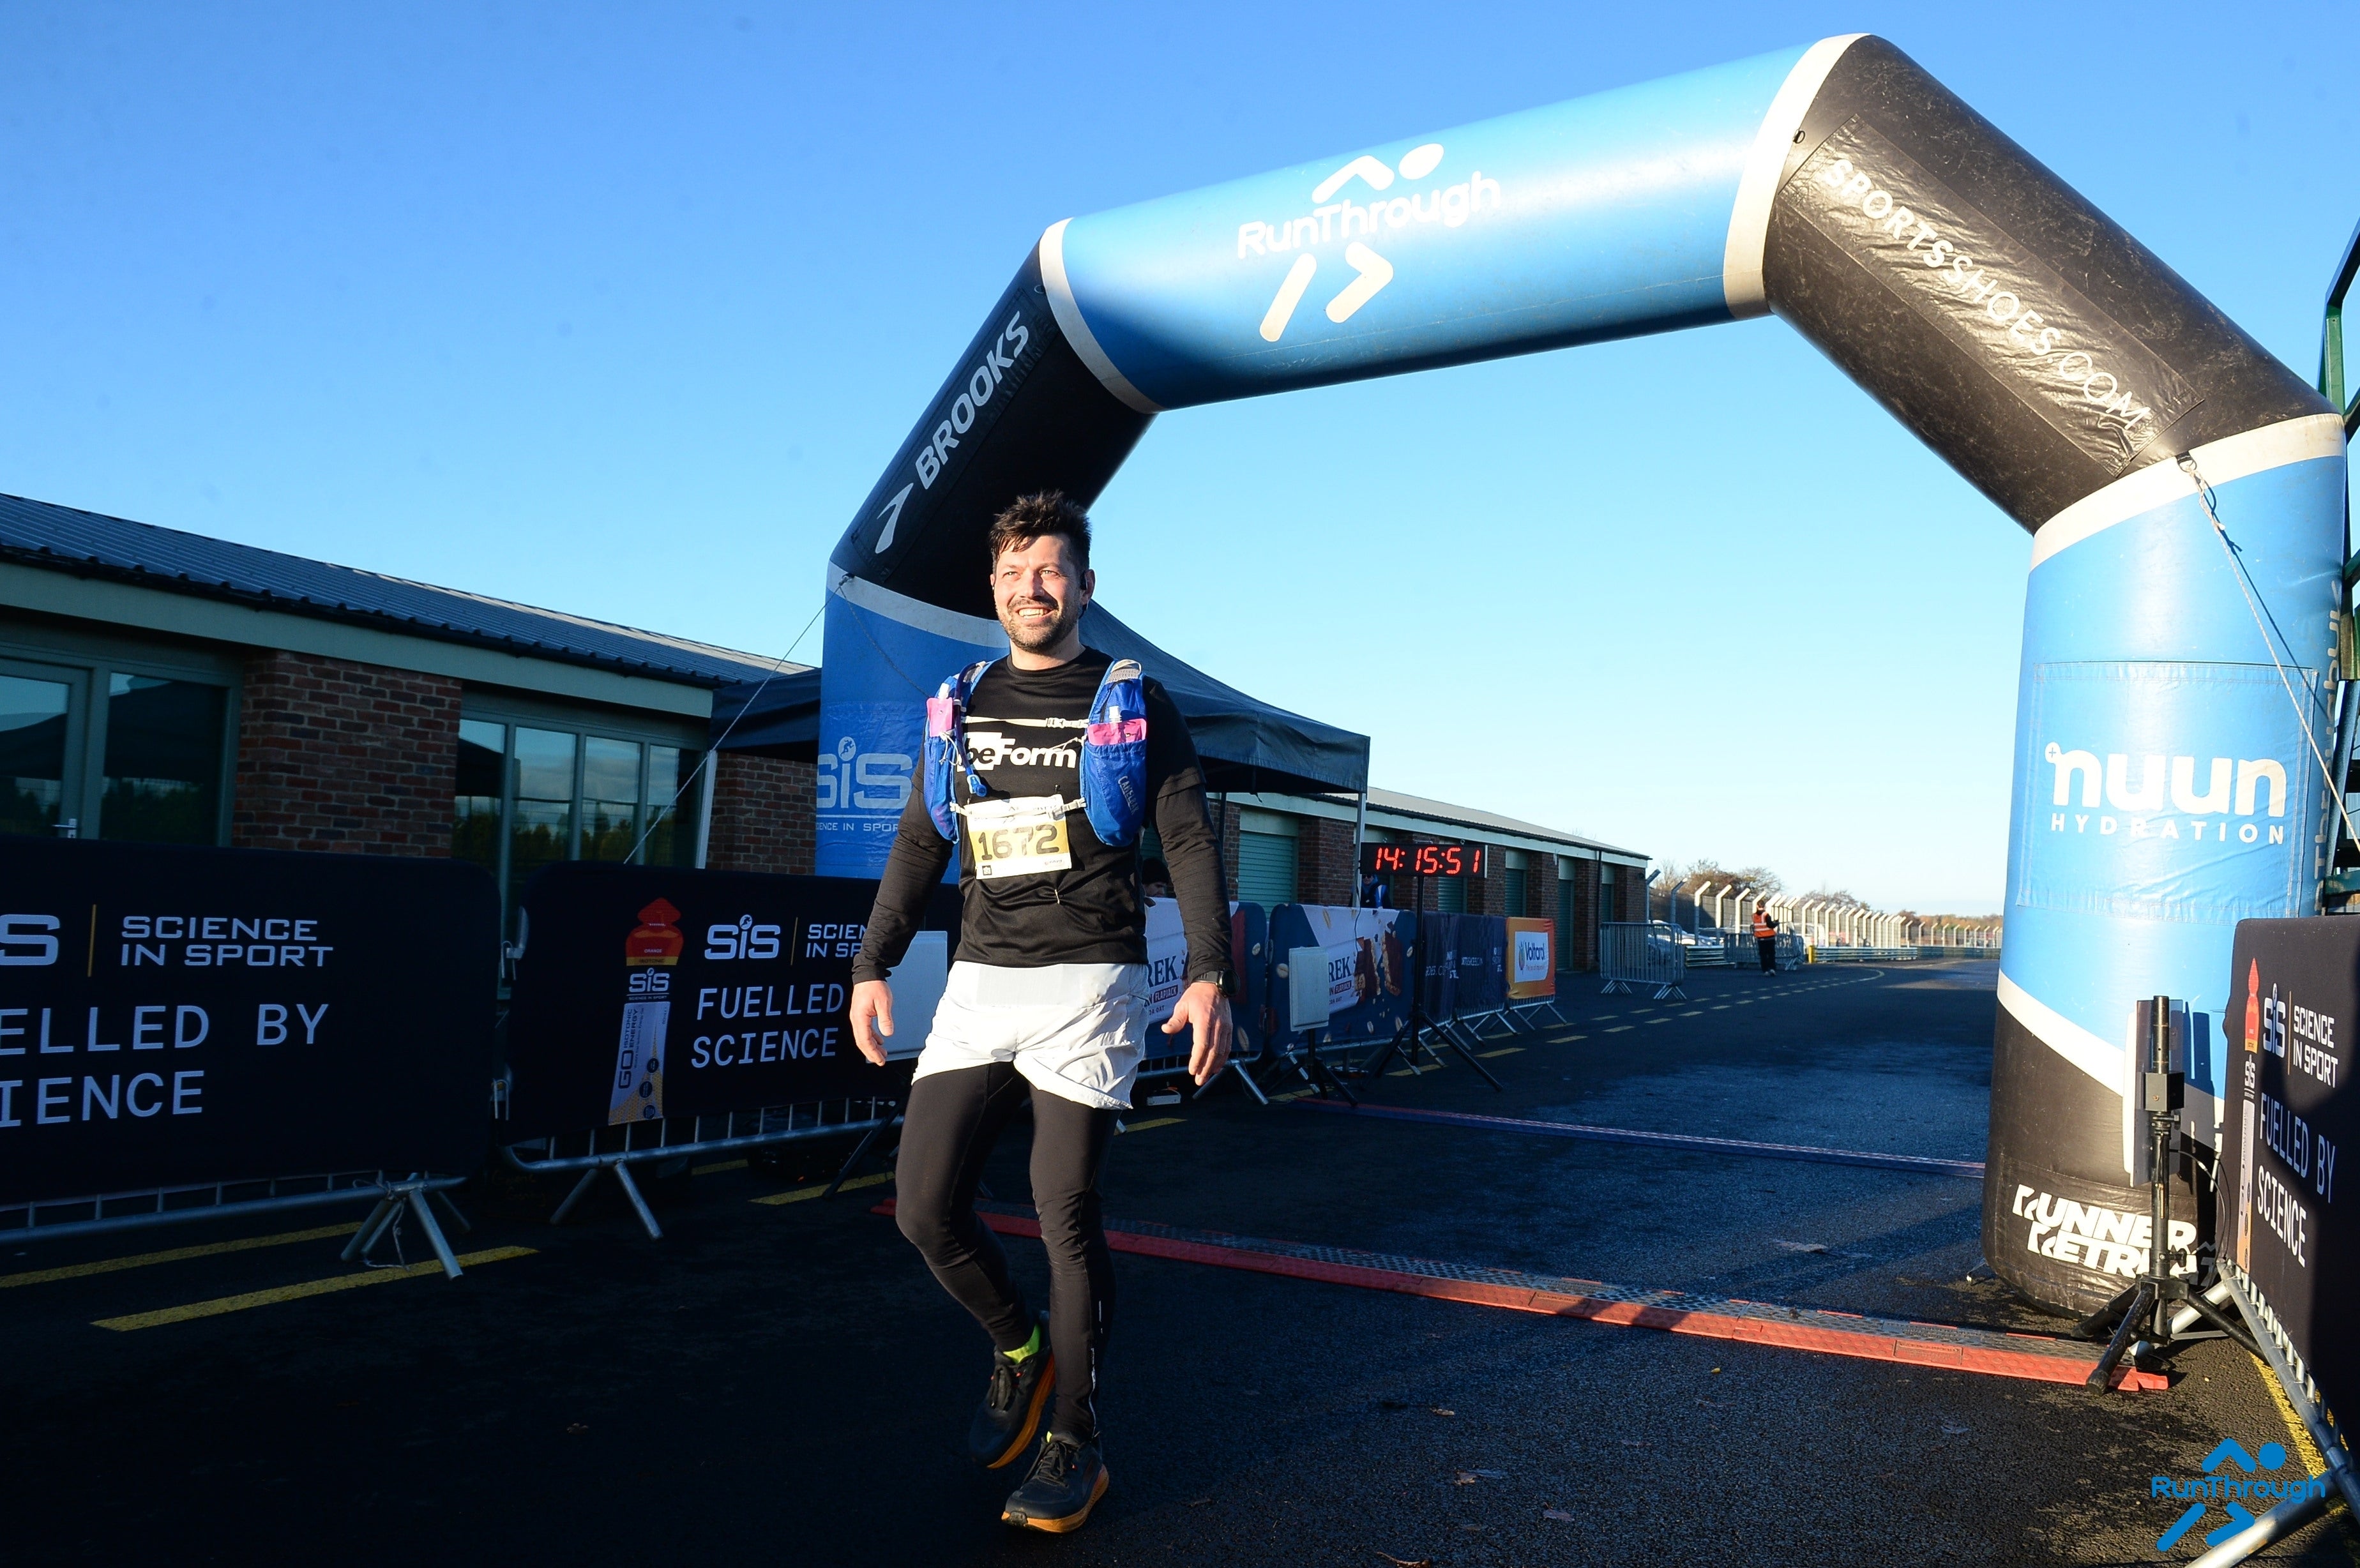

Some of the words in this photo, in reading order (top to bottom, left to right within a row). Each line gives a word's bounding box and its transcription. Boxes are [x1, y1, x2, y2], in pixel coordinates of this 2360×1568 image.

[1237, 170, 1501, 259] RunThrough
[1822, 158, 2151, 430] SPORTSSHOES.COM
[914, 310, 1029, 490] BROOKS
[2046, 744, 2287, 817] nuun
[843, 822, 854, 831] IN
[978, 824, 1060, 861] 1672
[2050, 813, 2285, 845] HYDRATION
[1375, 847, 1480, 875] 14:15:51
[121, 916, 319, 941] SCIENCE
[704, 914, 781, 960] SiS
[121, 944, 166, 966] IN
[185, 944, 334, 967] SPORT
[806, 942, 828, 958] IN
[629, 968, 670, 993] SiS
[697, 983, 844, 1020] FUELLED
[257, 1004, 329, 1046] BY
[623, 1008, 633, 1048] ISOTONIC
[629, 1008, 638, 1048] ENERGY
[2263, 983, 2286, 1059] SiS
[2294, 1005, 2335, 1049] SCIENCE
[618, 1049, 634, 1089] GO
[692, 1027, 838, 1069] SCIENCE
[2293, 1038, 2303, 1069] IN
[2304, 1044, 2338, 1088] SPORT
[2259, 1092, 2309, 1178] FUELLED
[2317, 1134, 2336, 1203] BY
[2013, 1184, 2197, 1254] RUNNER
[2257, 1165, 2306, 1268] SCIENCE
